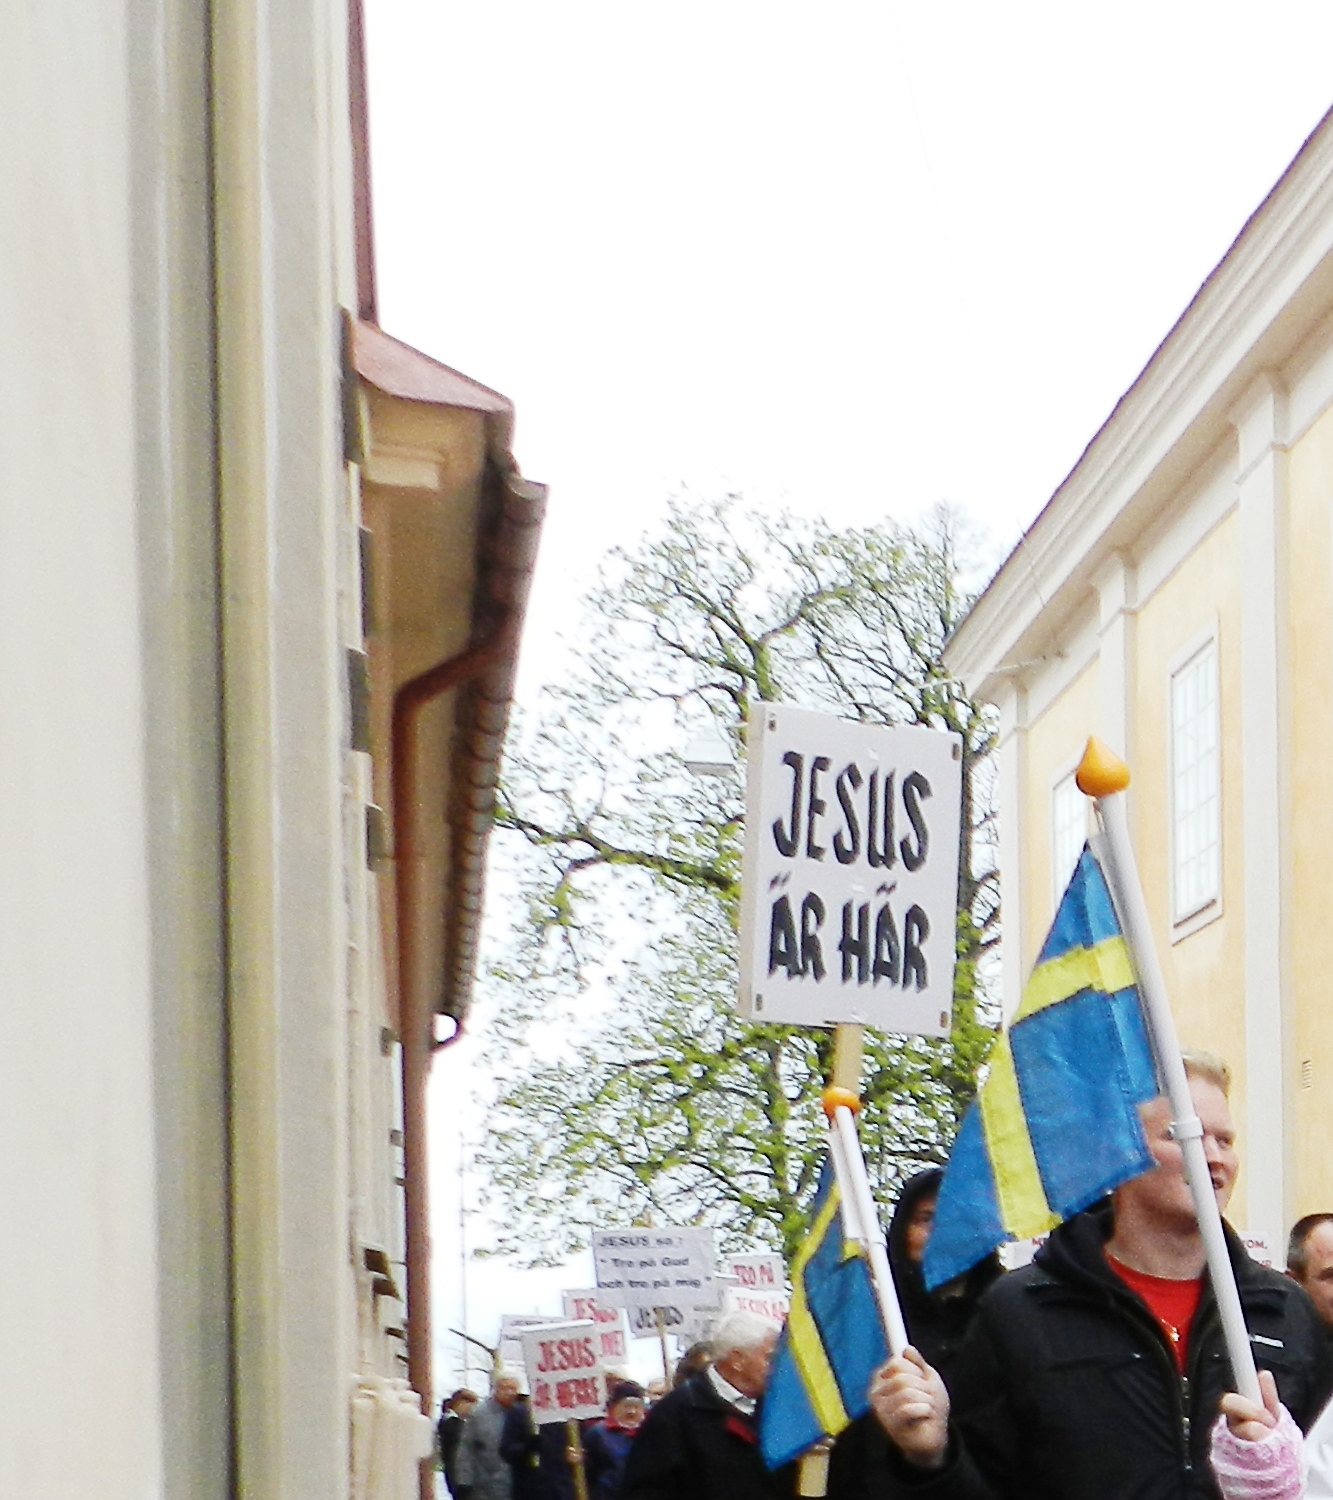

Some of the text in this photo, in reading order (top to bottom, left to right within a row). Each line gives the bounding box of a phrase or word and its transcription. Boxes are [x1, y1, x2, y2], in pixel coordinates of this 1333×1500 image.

[773, 751, 933, 872] JESUS
[768, 872, 930, 993] ÄR HÄR
[598, 1236, 649, 1246] JESUS
[537, 1337, 596, 1373] JESUS
